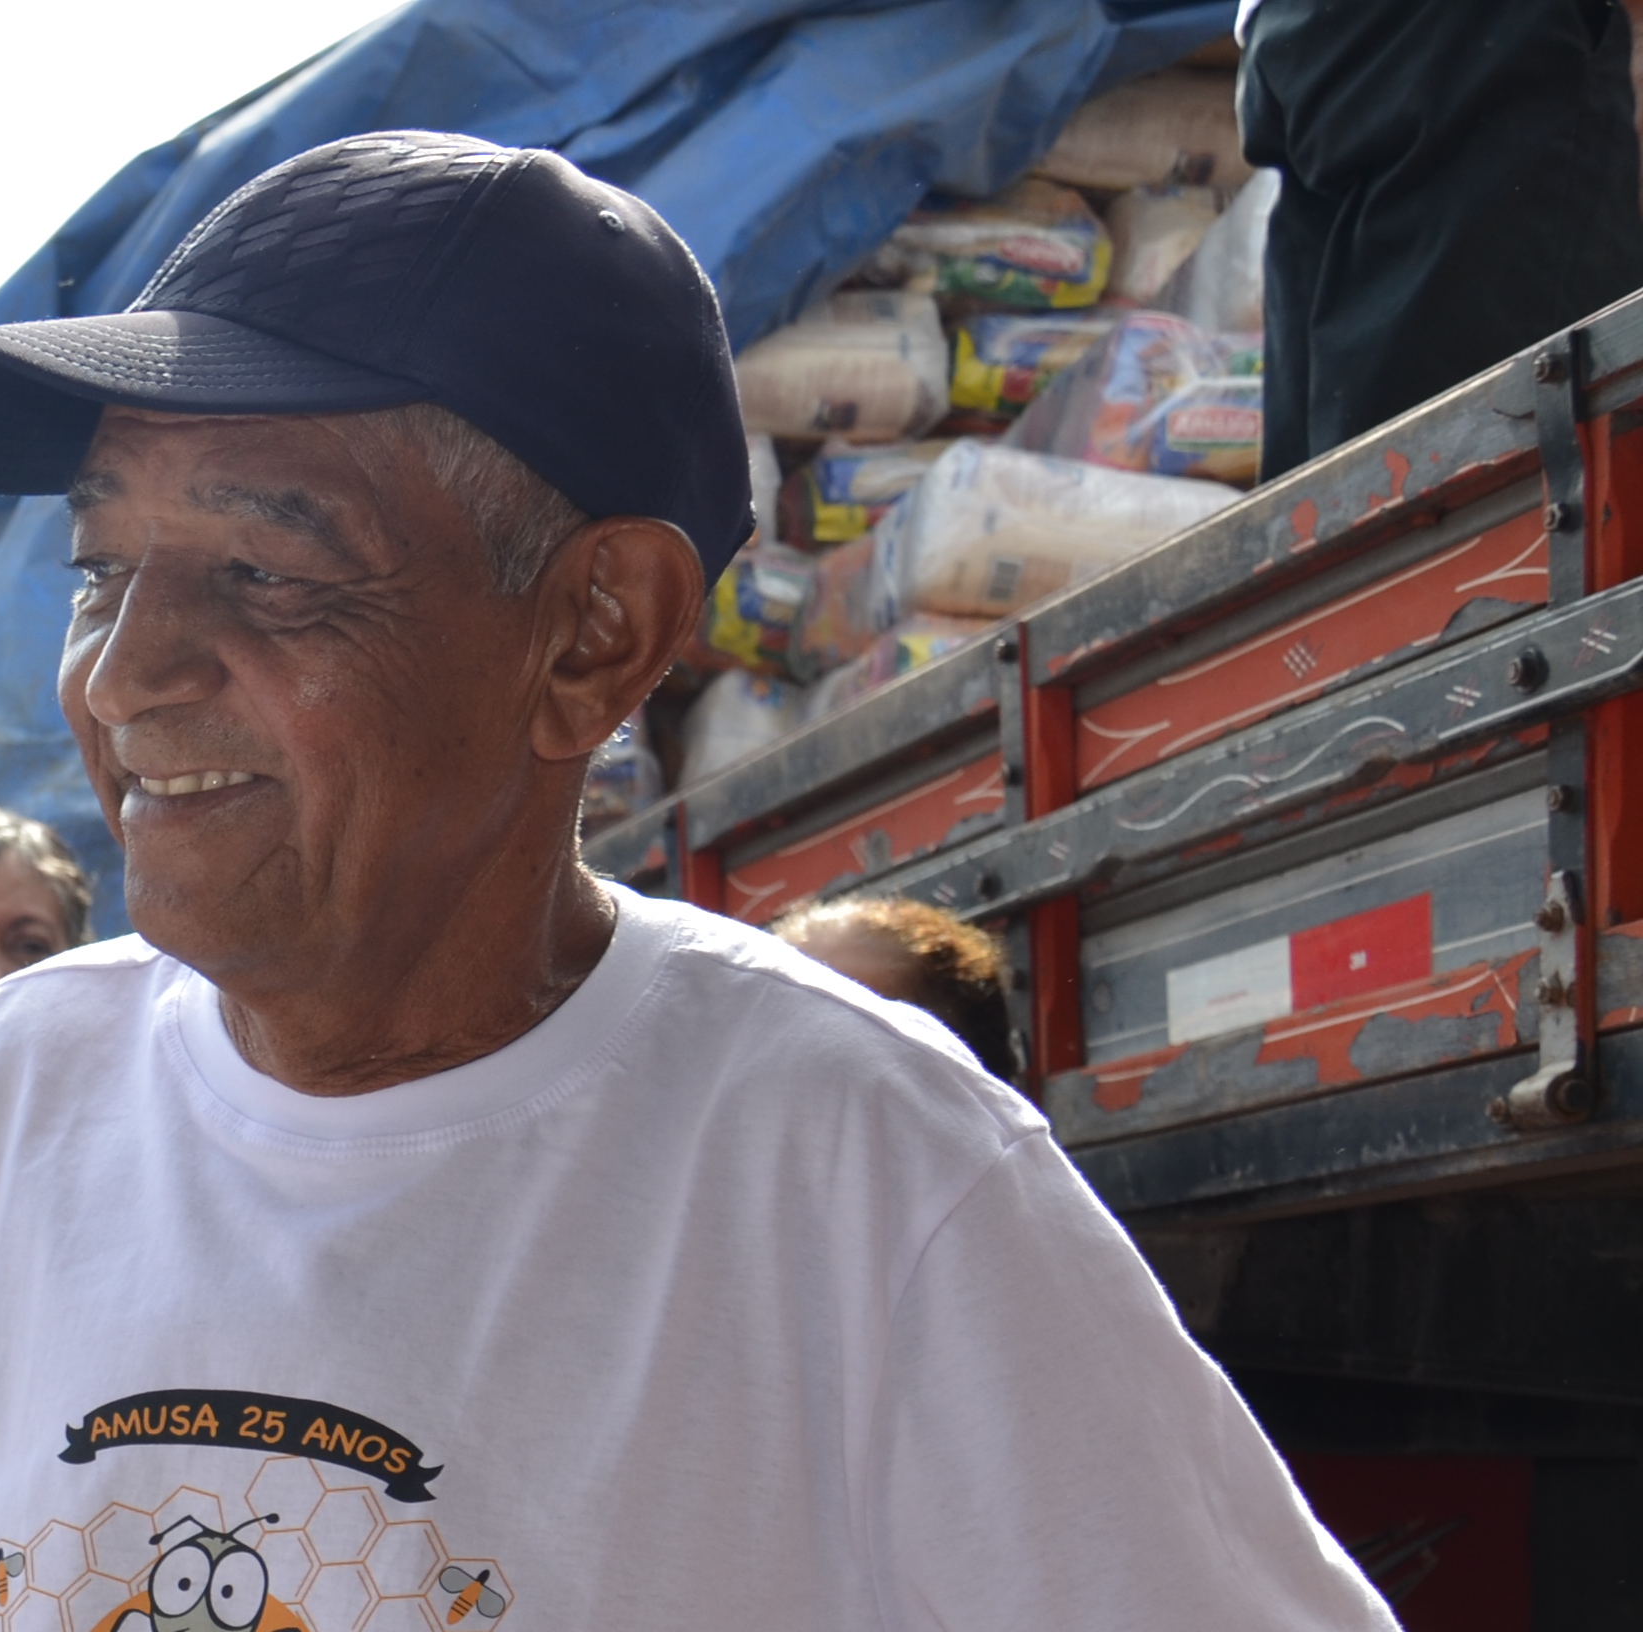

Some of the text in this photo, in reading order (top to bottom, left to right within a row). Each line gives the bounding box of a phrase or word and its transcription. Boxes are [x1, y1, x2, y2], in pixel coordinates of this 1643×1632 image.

[90, 1402, 412, 1474] AMUSA 25 ANOS
